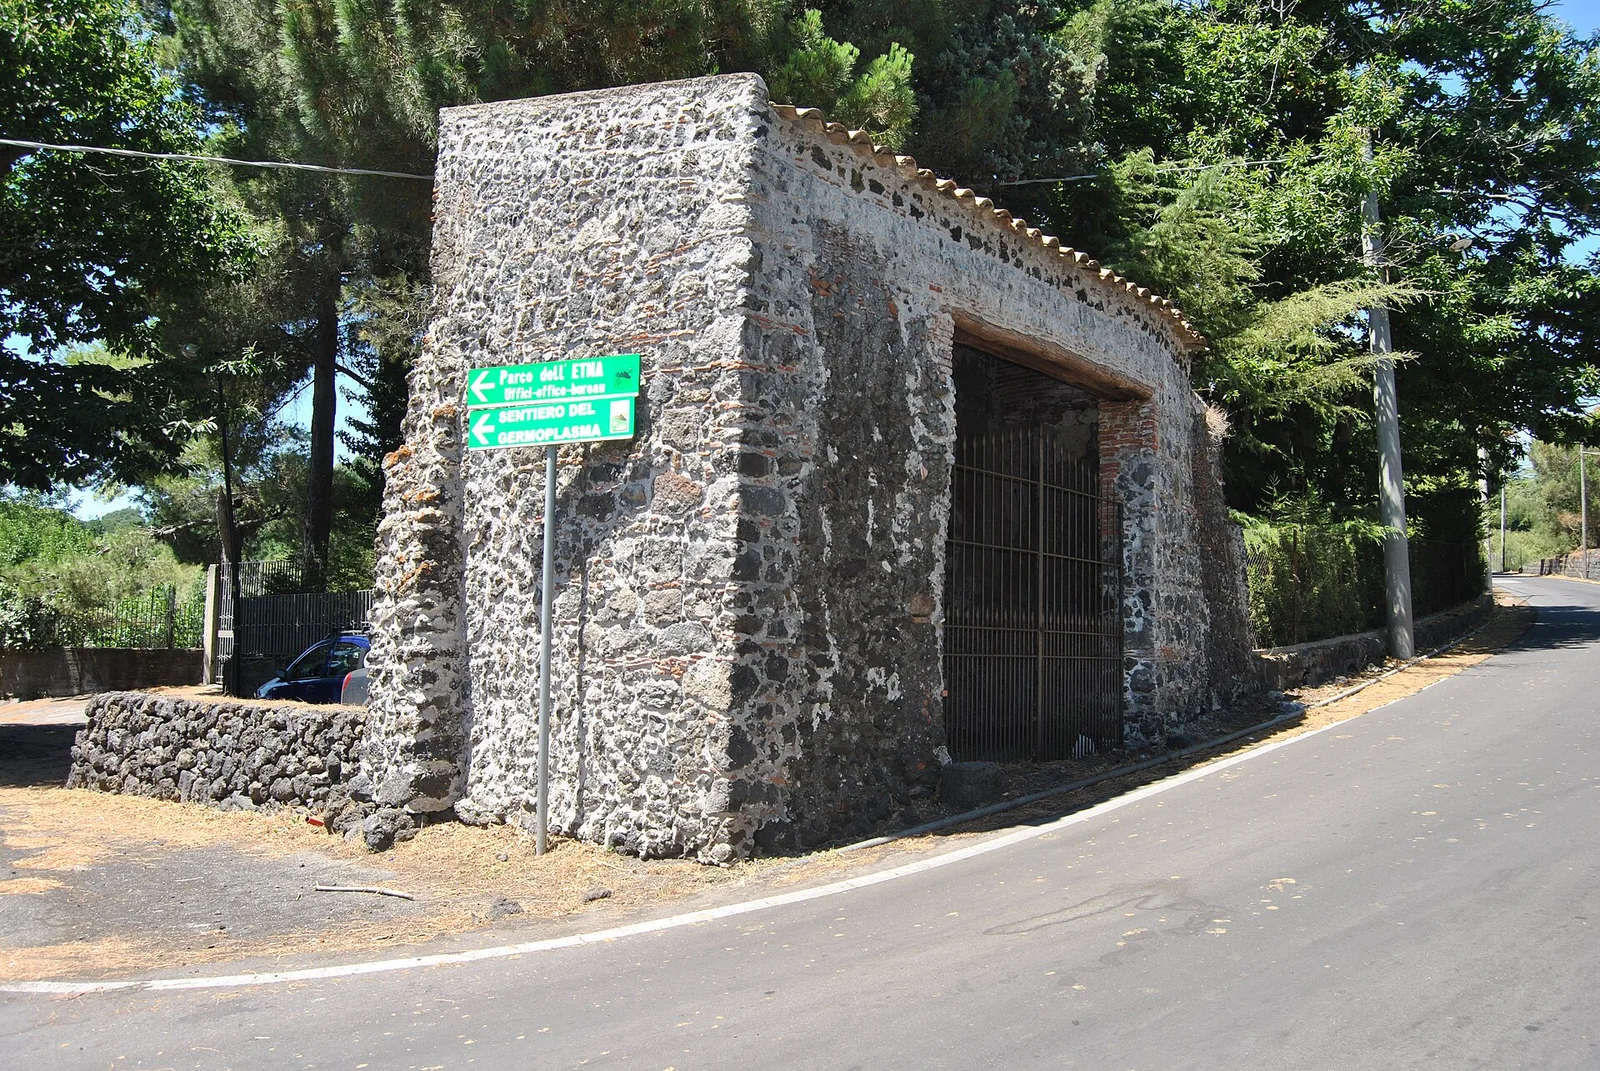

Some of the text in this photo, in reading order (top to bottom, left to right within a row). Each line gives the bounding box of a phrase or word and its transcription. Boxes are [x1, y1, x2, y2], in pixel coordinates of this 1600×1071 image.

[500, 370, 533, 385] Parco
[572, 361, 604, 379] ETNA
[499, 403, 595, 423] SENTIERO DEL
[498, 424, 601, 444] GERMOPLASMA
